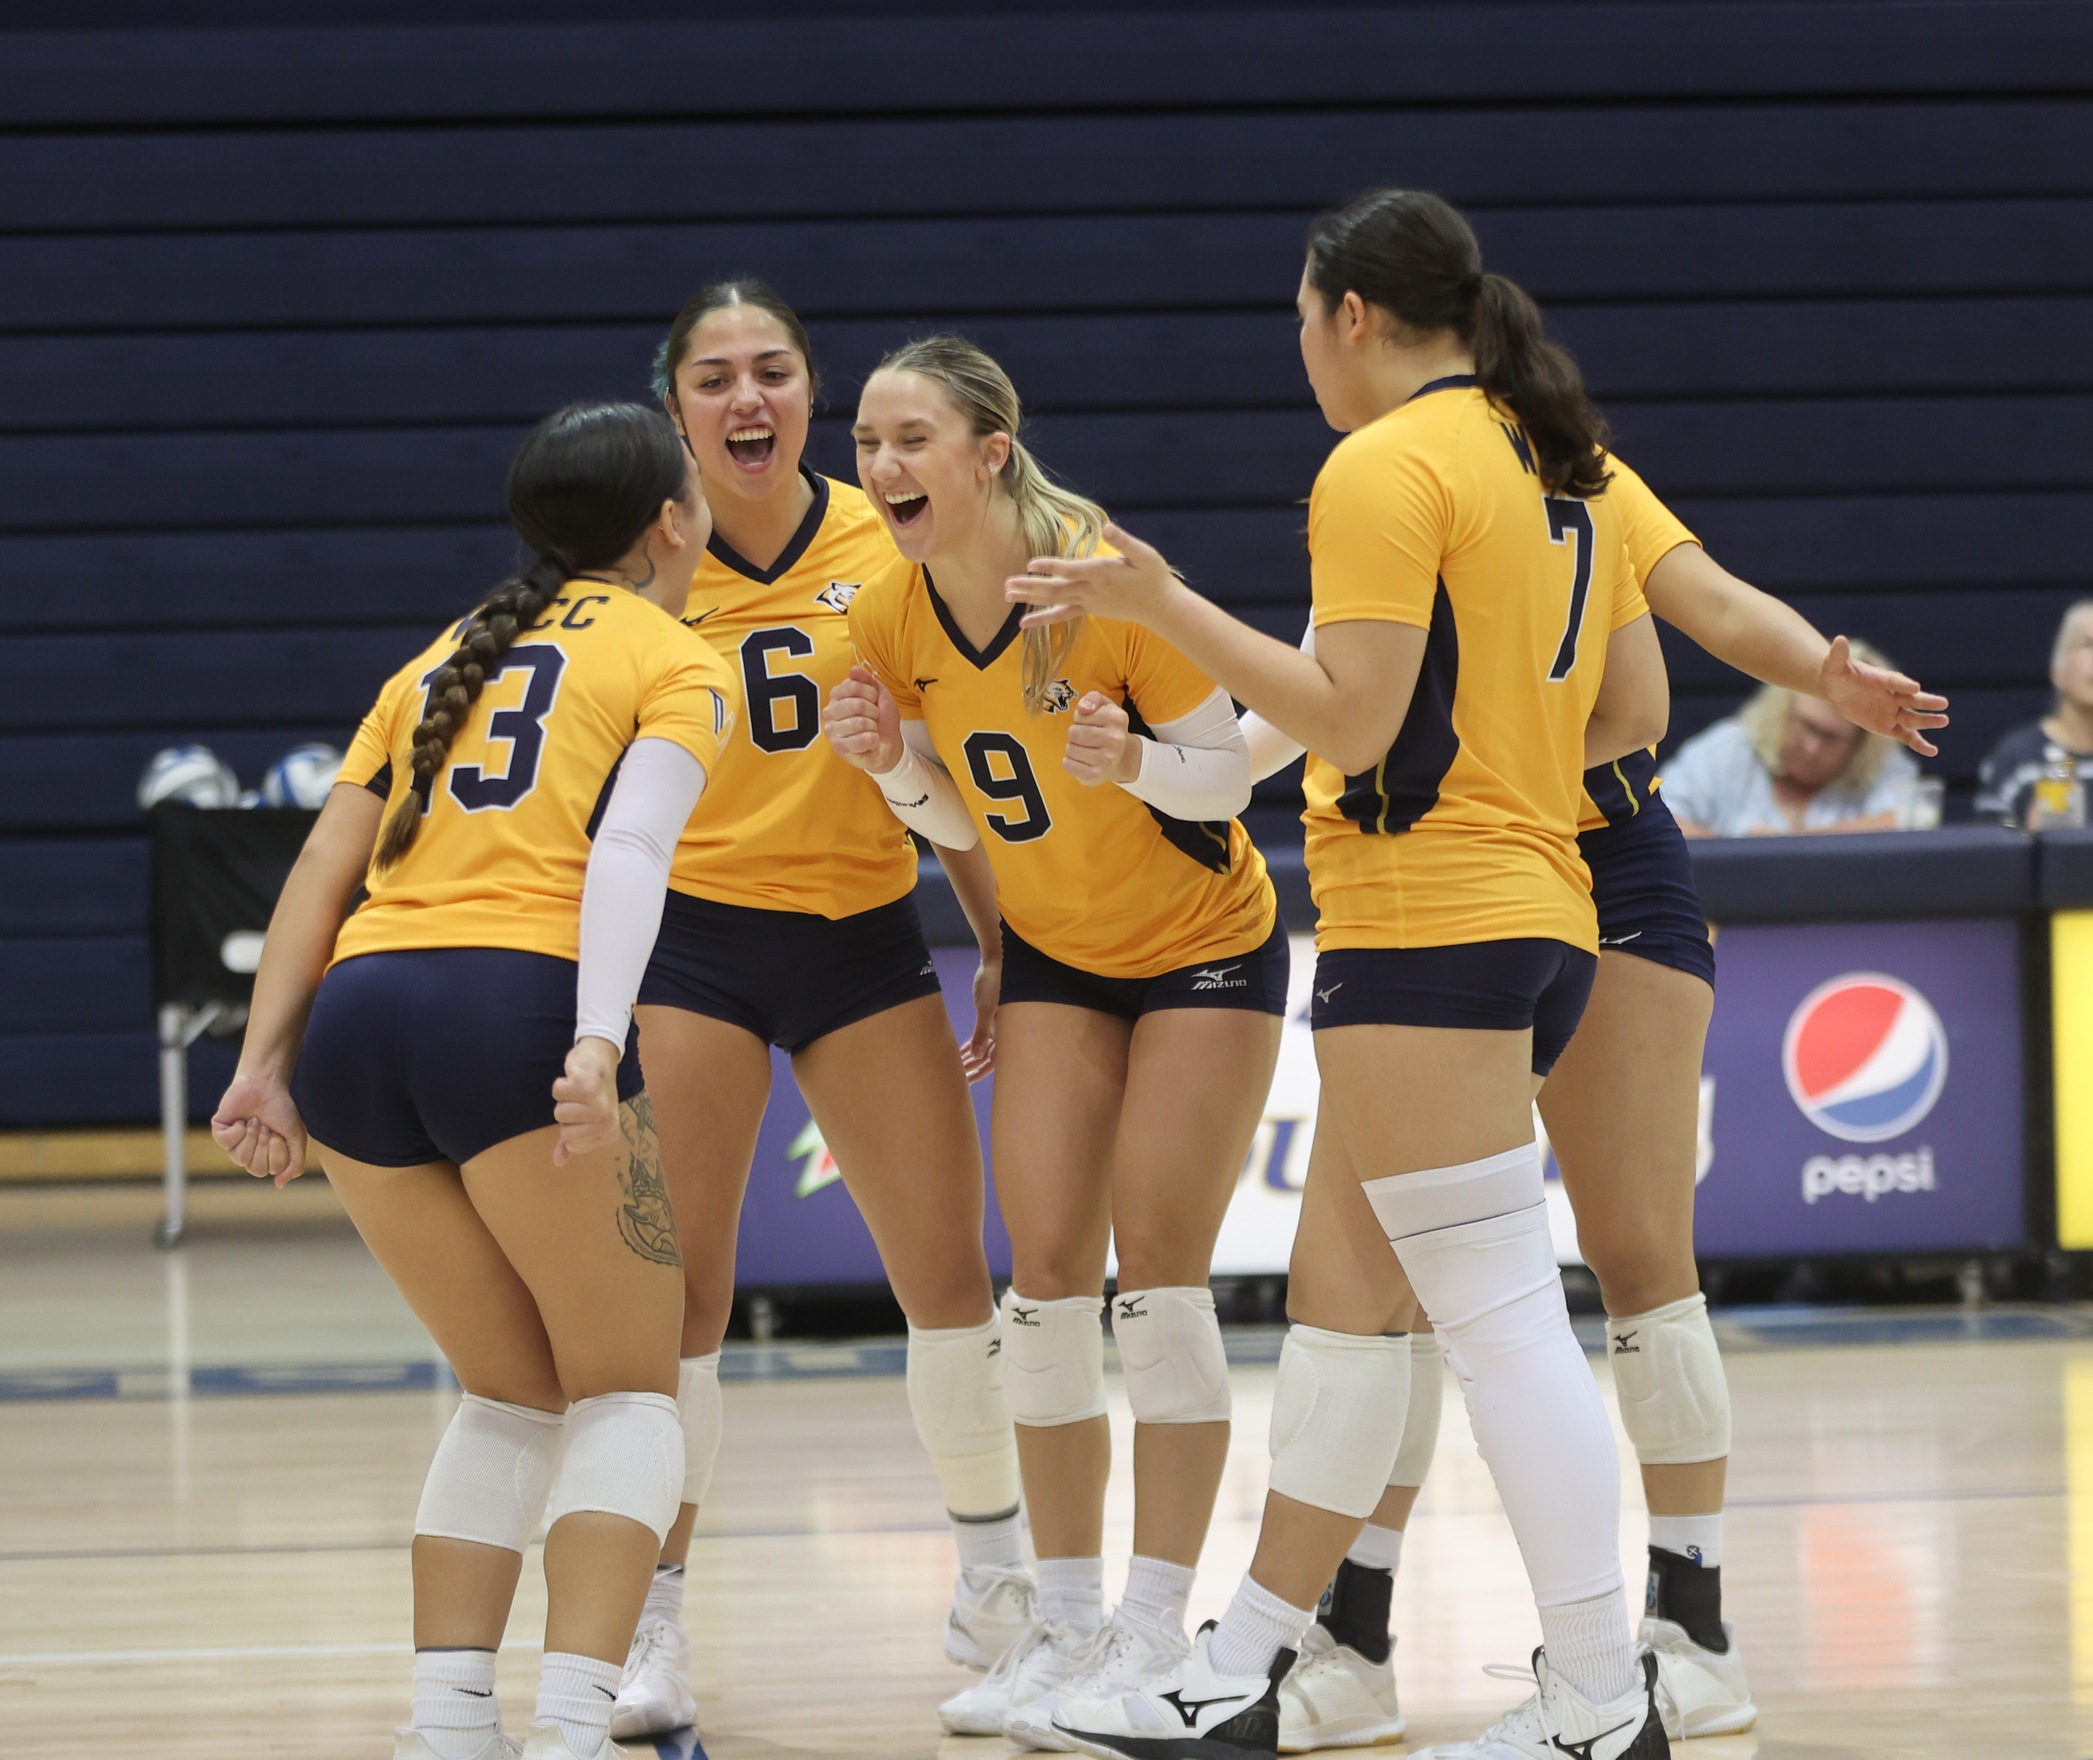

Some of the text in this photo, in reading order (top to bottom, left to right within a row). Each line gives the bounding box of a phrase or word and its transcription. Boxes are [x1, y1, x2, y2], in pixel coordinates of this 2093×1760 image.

[1542, 493, 1595, 682] 7
[738, 624, 821, 755] 6
[962, 731, 1054, 844] 9
[1801, 1144, 1937, 1206] pepsi
